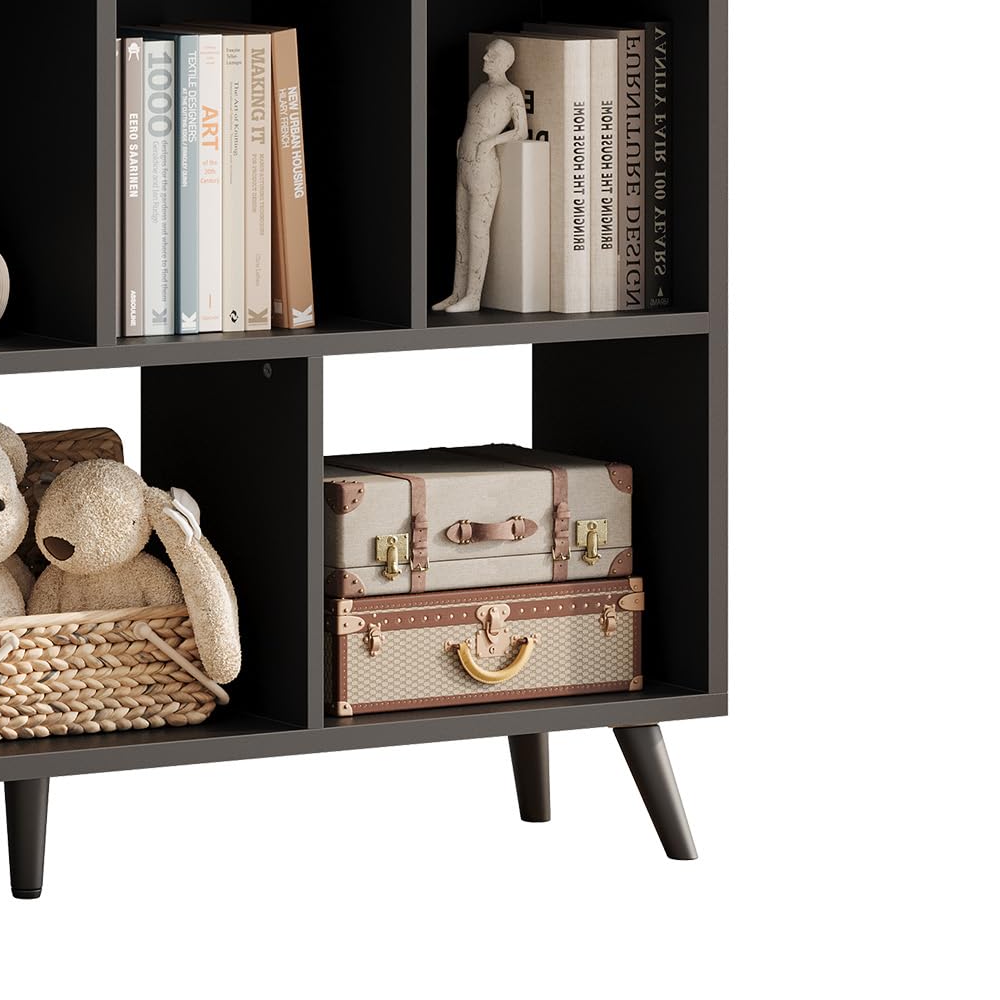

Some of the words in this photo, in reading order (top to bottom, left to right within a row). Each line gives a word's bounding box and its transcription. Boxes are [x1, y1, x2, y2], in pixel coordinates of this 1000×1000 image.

[188, 50, 197, 88] TEXTILE
[147, 52, 173, 138] 1000
[251, 48, 265, 121] MAKING
[288, 86, 298, 111] NEW
[188, 89, 197, 143] DESIGNERS
[233, 112, 239, 120] of
[279, 88, 288, 115] HILARY
[129, 113, 138, 141] EERO
[201, 105, 219, 151] ART
[251, 127, 265, 144] IT
[280, 117, 290, 149] FRENCH
[289, 112, 301, 151] URBAN
[160, 140, 169, 167] designs
[129, 143, 138, 198] SAARINEN
[161, 168, 169, 178] for
[161, 180, 169, 191] the
[292, 152, 305, 199] HOUSING
[161, 260, 168, 268] to
